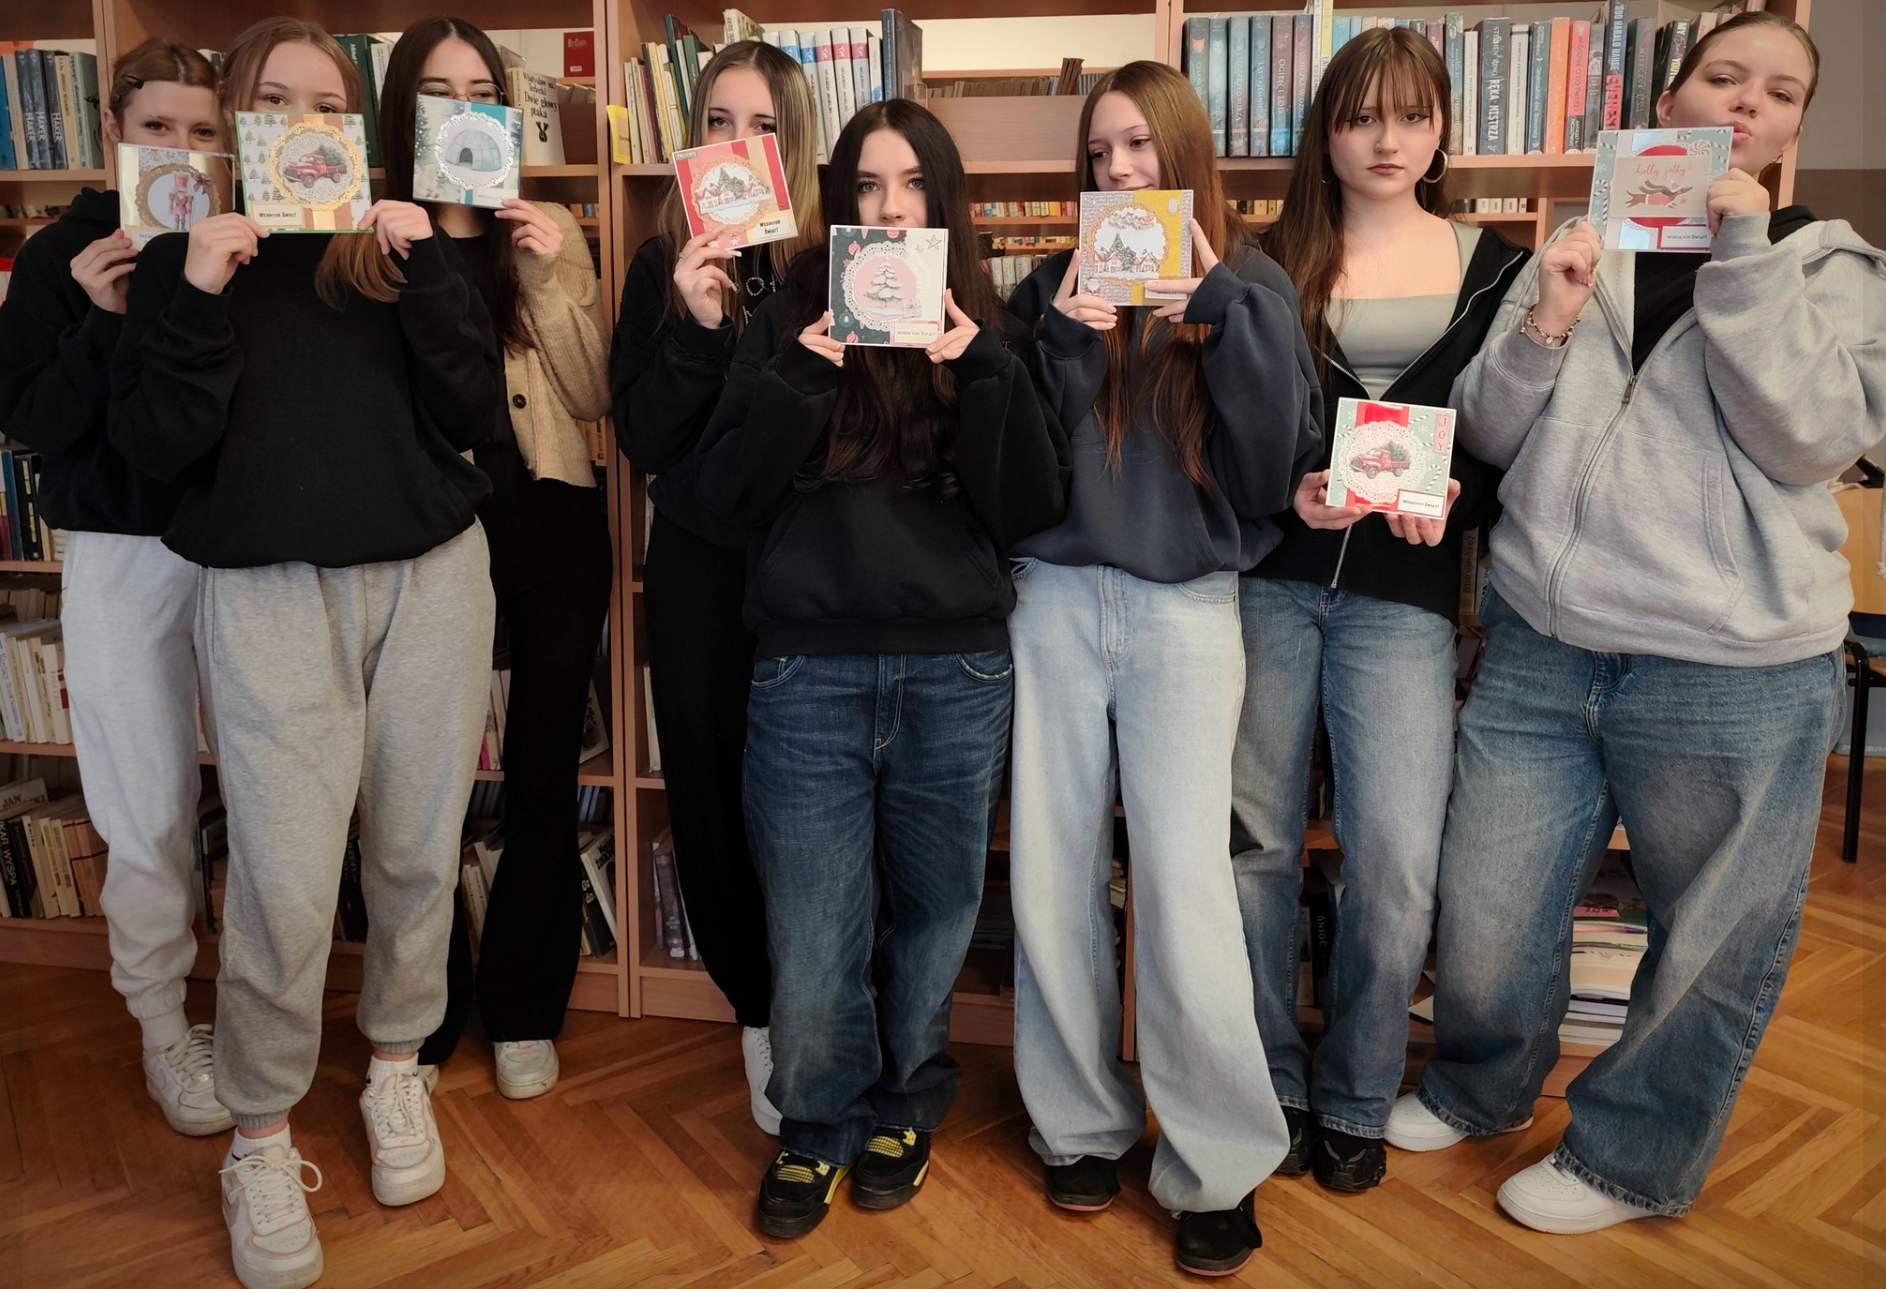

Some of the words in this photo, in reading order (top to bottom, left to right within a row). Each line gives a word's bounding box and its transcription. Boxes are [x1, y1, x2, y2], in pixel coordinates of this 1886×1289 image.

[1612, 20, 1622, 46] HARALD
[1676, 22, 1687, 36] MY
[1492, 58, 1500, 76] KING
[1610, 48, 1621, 70] HAUGE
[1487, 80, 1500, 100] RĘKA
[524, 91, 540, 106] Dwie
[540, 100, 558, 112] głowy
[530, 107, 548, 119] ptaka
[1488, 106, 1500, 140] MISTRZA
[24, 112, 35, 142] HAKER
[36, 111, 46, 141] HAKER
[52, 112, 63, 142] HAKER
[1634, 164, 1660, 180] holly
[1438, 417, 1447, 451] JOY
[2, 794, 21, 808] JAN
[2, 849, 18, 886] WYSPA
